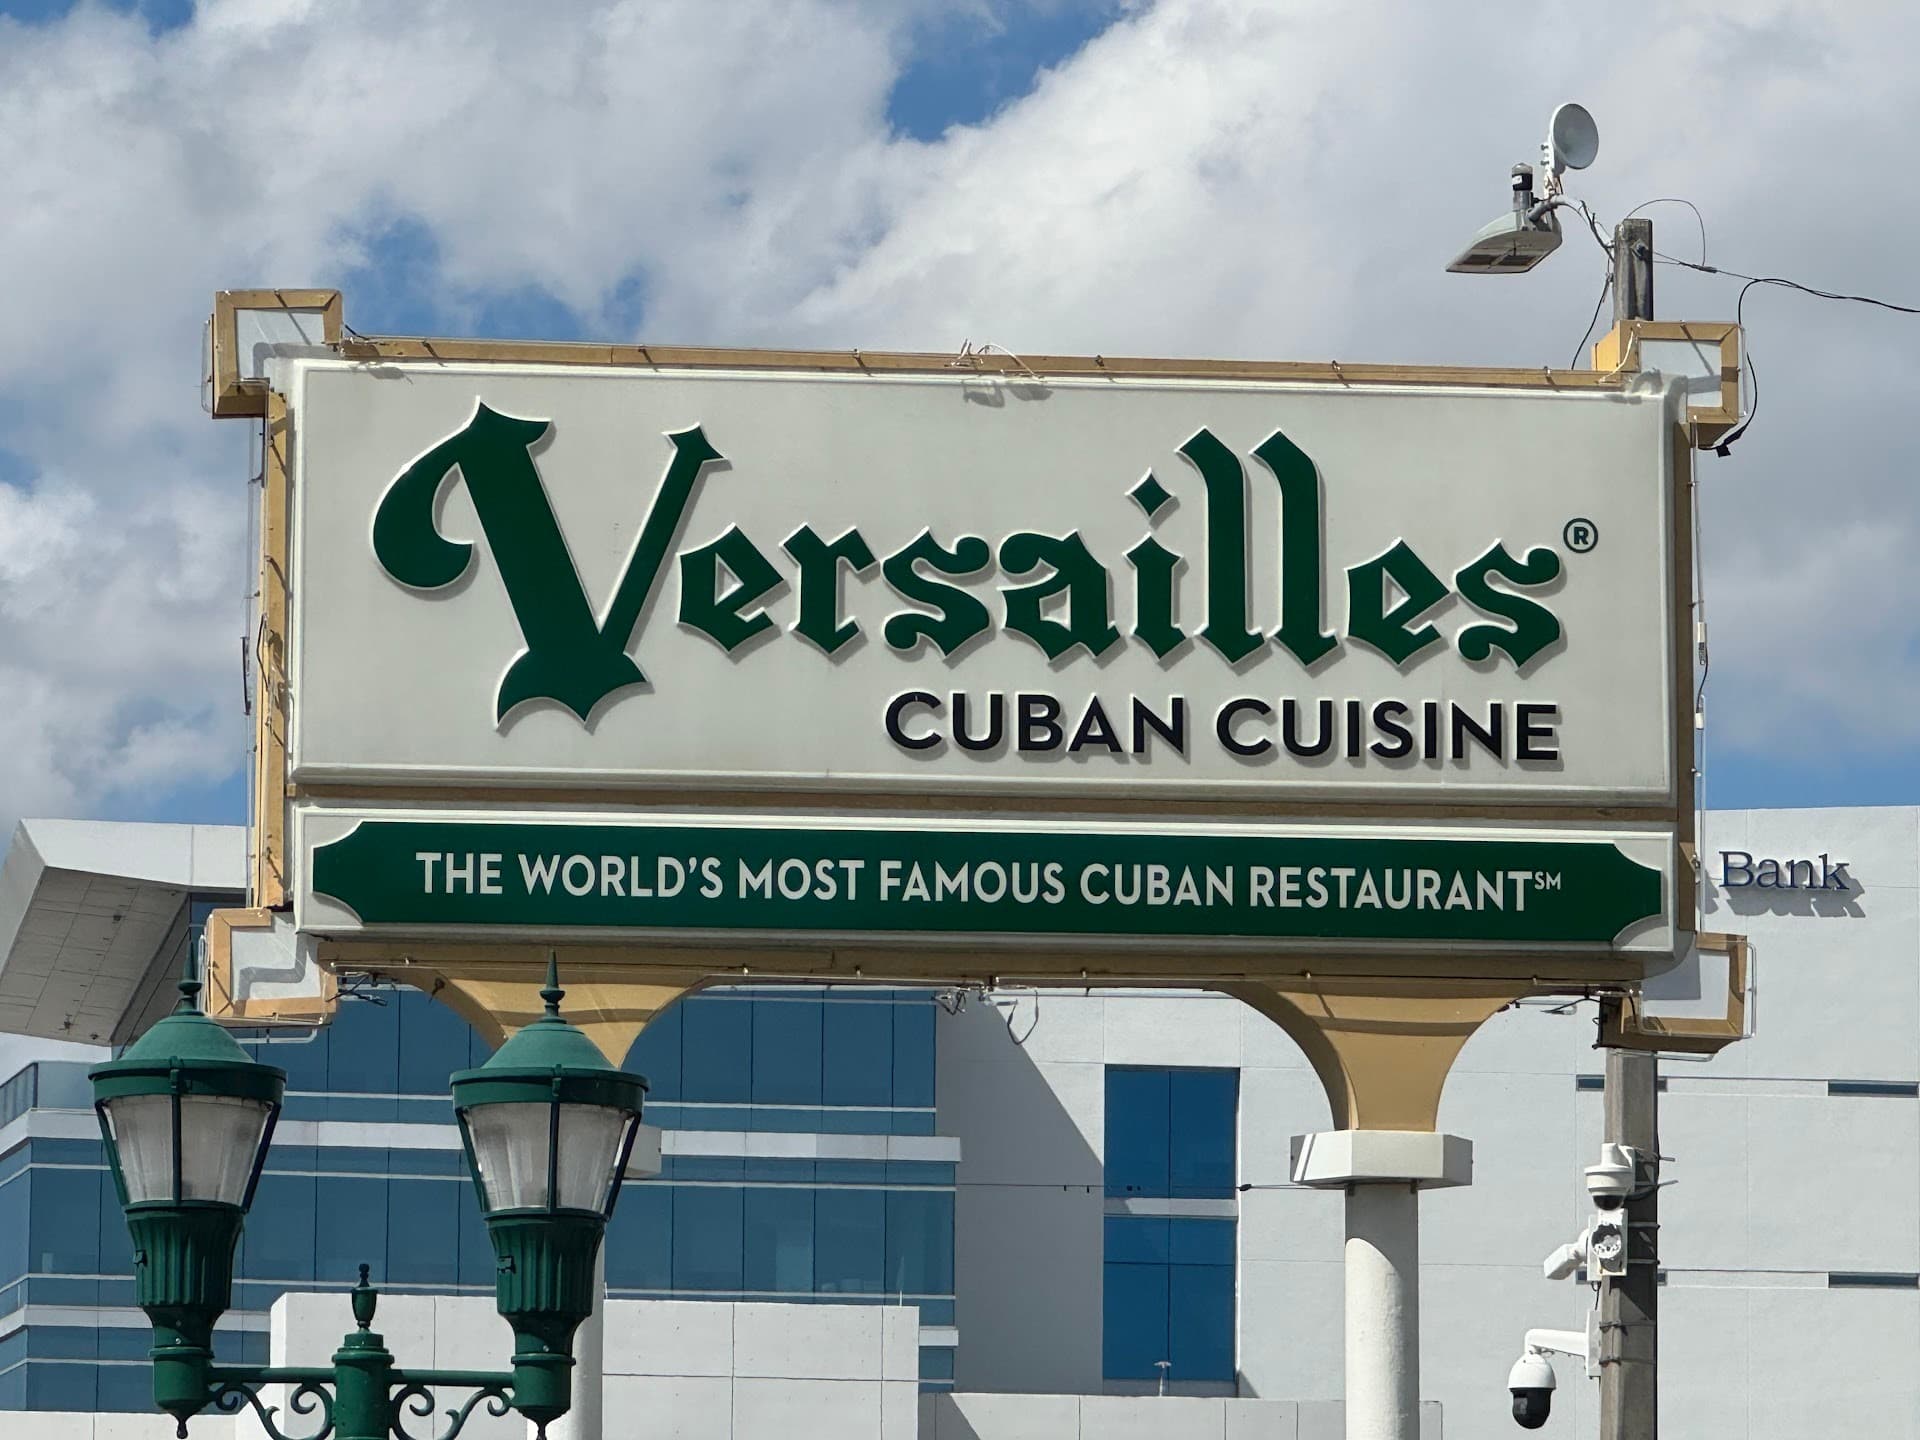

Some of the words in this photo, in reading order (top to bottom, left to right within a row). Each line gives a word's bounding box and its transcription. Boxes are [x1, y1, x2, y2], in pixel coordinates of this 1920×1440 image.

[373, 401, 1561, 732] Versailles
[886, 691, 1185, 755] CUBAN
[1217, 698, 1558, 763] CUISINE
[415, 852, 503, 895] THE
[517, 853, 723, 899] WORLD'S
[739, 858, 865, 901] MOST
[880, 860, 1066, 904] FAMOUS
[1080, 863, 1234, 906] CUBAN
[1719, 851, 1850, 891] Bank
